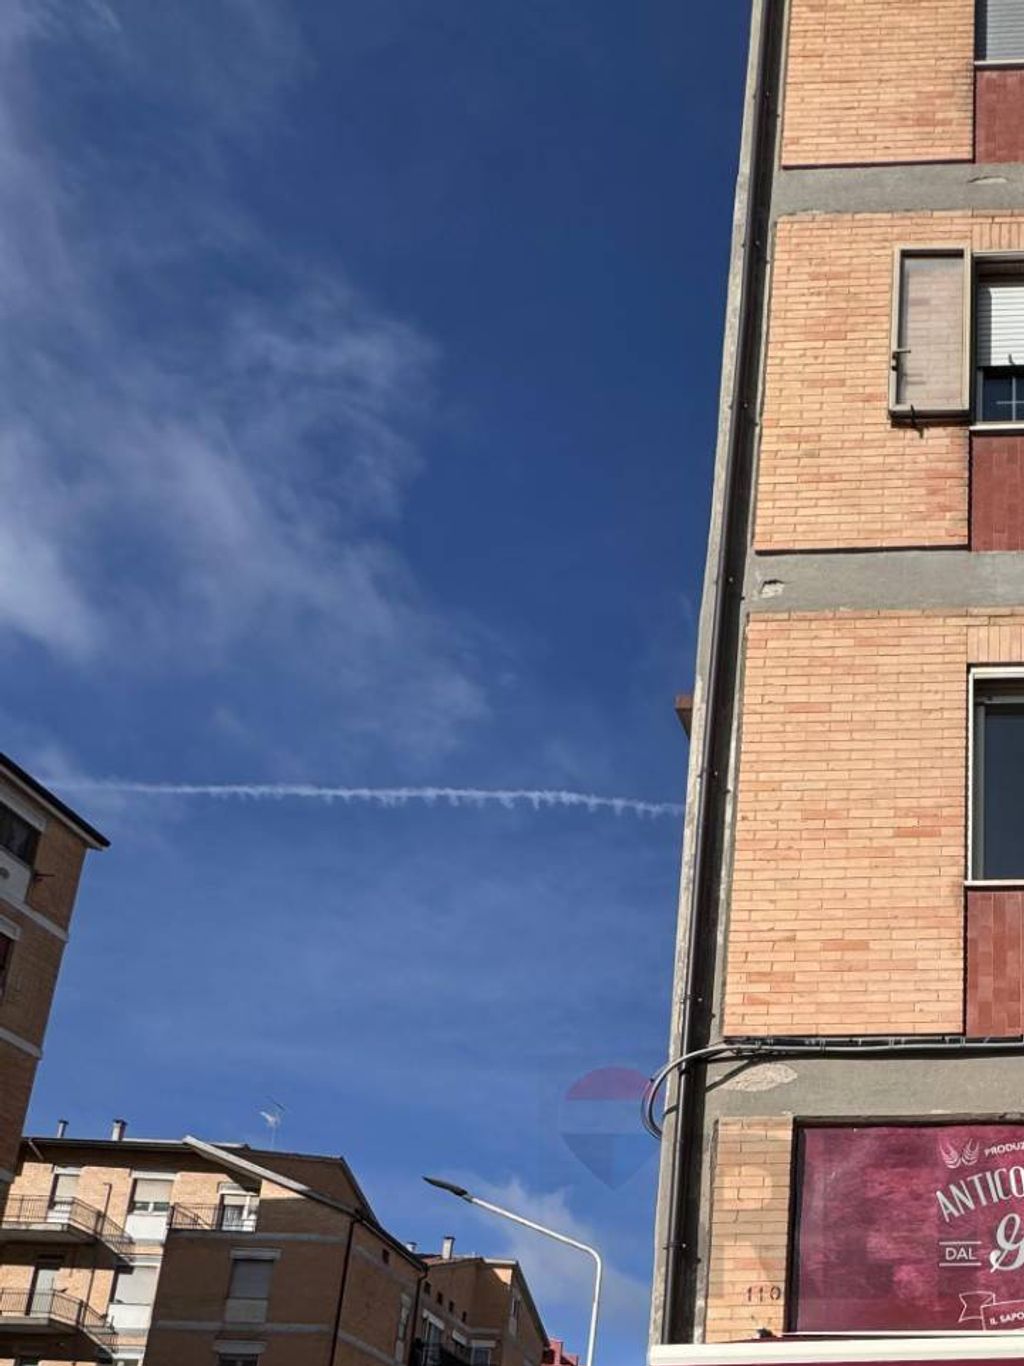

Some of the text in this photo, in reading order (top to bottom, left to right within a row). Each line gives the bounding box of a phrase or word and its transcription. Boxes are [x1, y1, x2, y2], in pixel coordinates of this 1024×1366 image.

[945, 1247, 976, 1261] DAL
[747, 1285, 781, 1302] 110
[989, 1317, 999, 1326] IL
